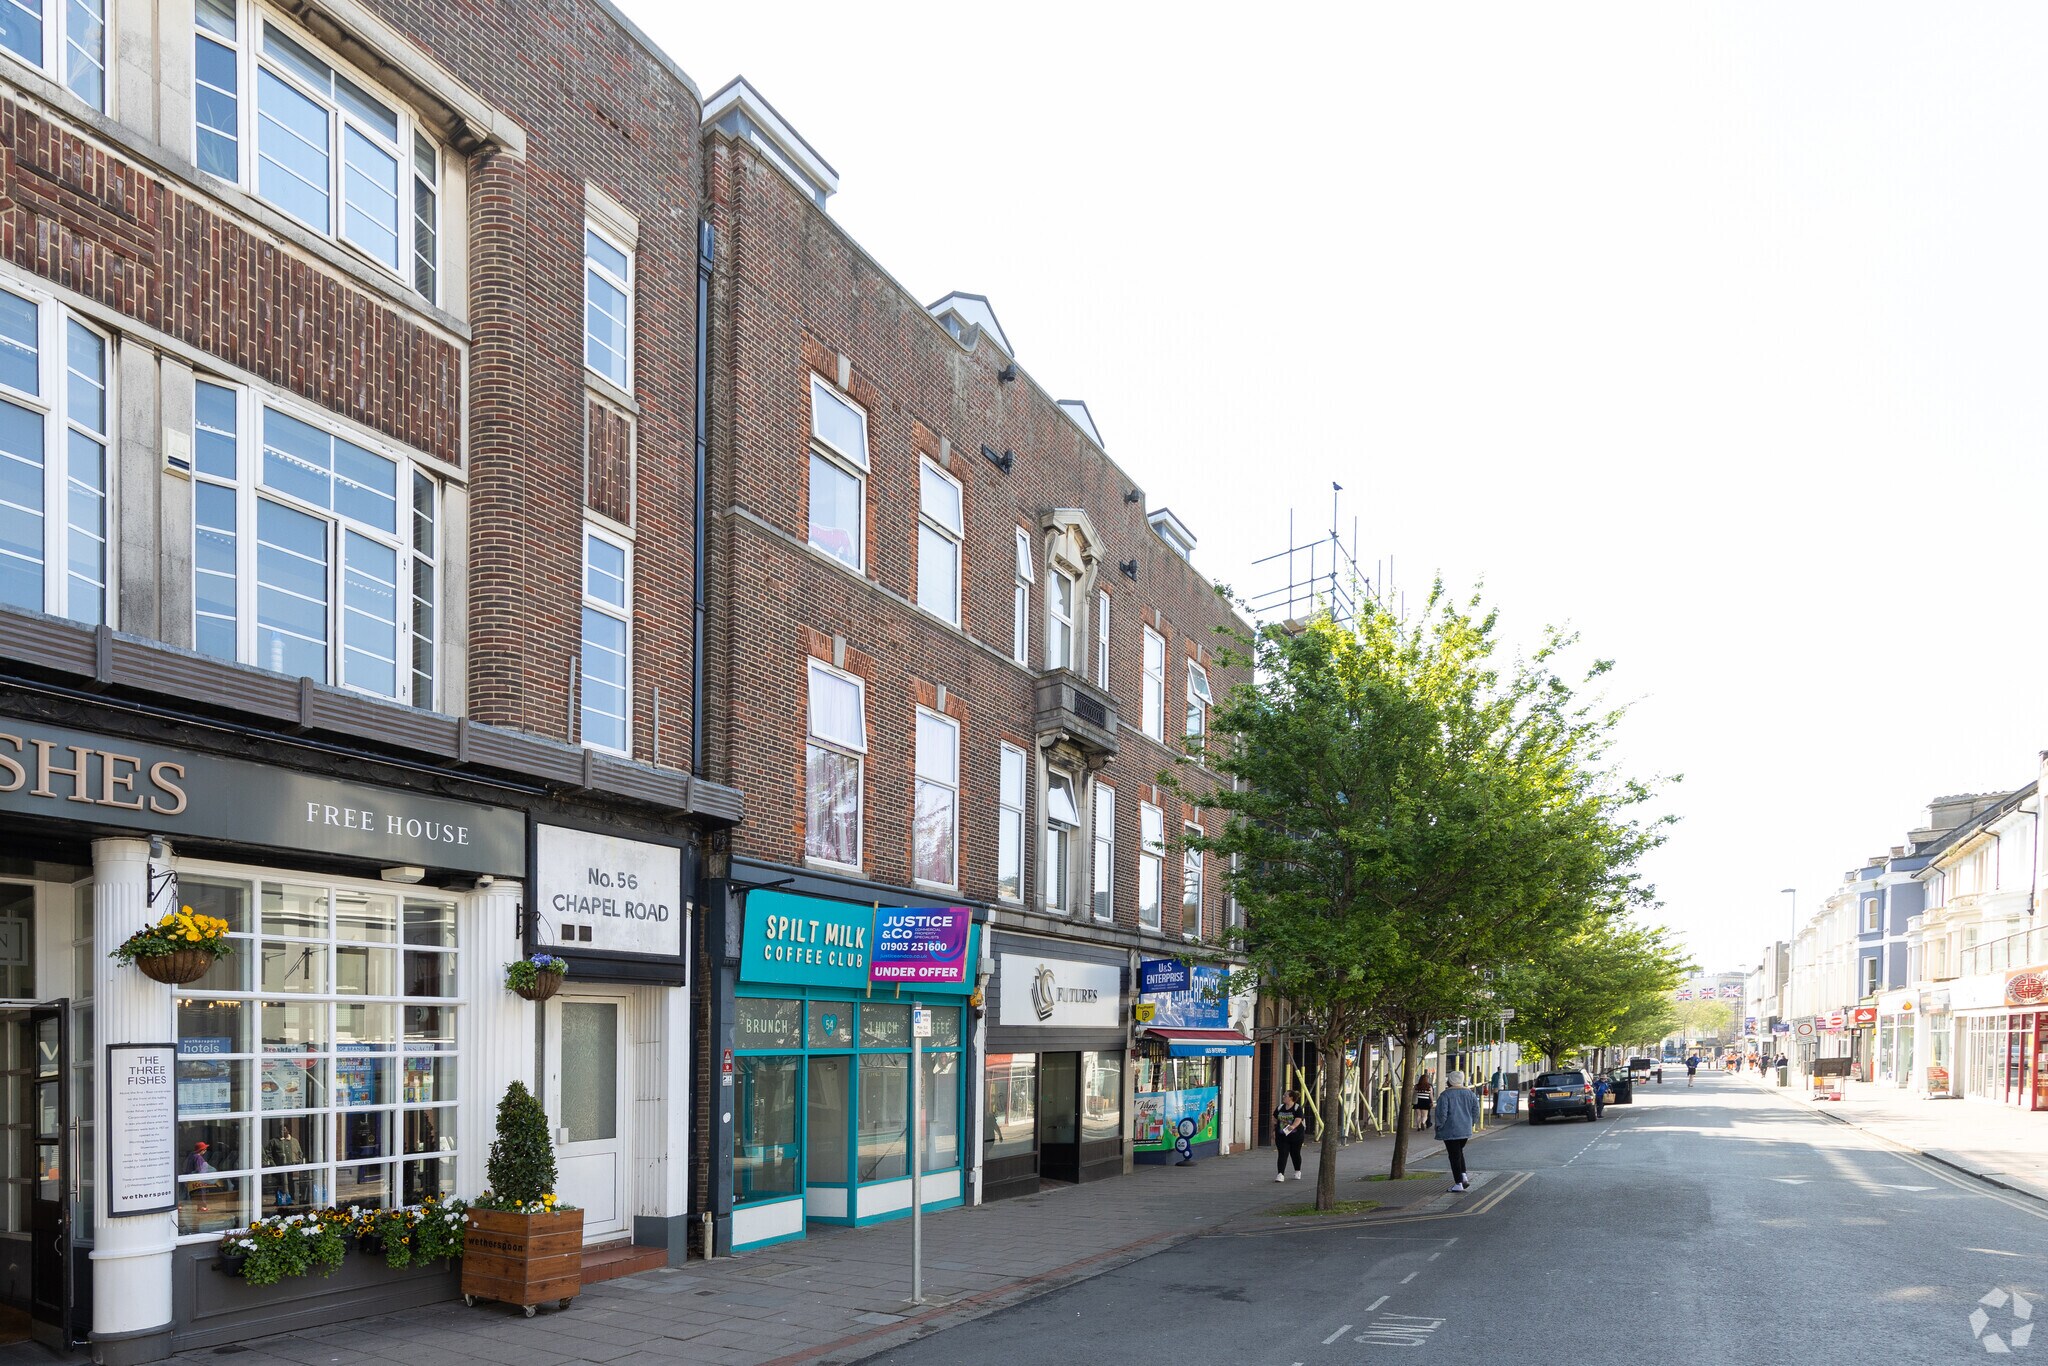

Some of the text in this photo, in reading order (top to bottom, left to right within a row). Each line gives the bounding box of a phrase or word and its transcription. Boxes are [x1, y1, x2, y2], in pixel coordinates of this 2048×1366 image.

[306, 802, 469, 845] FREE HOUSE
[588, 868, 638, 890] No. 56
[552, 894, 669, 922] CHAPEL ROAD
[882, 916, 953, 927] JUSTICE
[766, 914, 865, 949] SPILT MILK
[882, 928, 912, 939] &Co
[881, 942, 947, 951] 01903 251600
[764, 945, 863, 968] COFFEE CLUB
[875, 967, 959, 977] UNDER OFFER
[1158, 962, 1173, 973] U&S
[1146, 972, 1184, 985] ENTERPRISE
[1056, 987, 1098, 1004] FUTURES
[746, 1019, 788, 1034] BRUNCH
[825, 1020, 834, 1030] 54
[183, 1043, 220, 1053] hotels
[137, 1056, 159, 1065] THE
[128, 1066, 166, 1075] THREE
[127, 1076, 167, 1085] FISHES
[121, 1190, 172, 1201] wetherspoon
[468, 1238, 523, 1252] wetherspoon
[1353, 1312, 1447, 1346] ONLY
